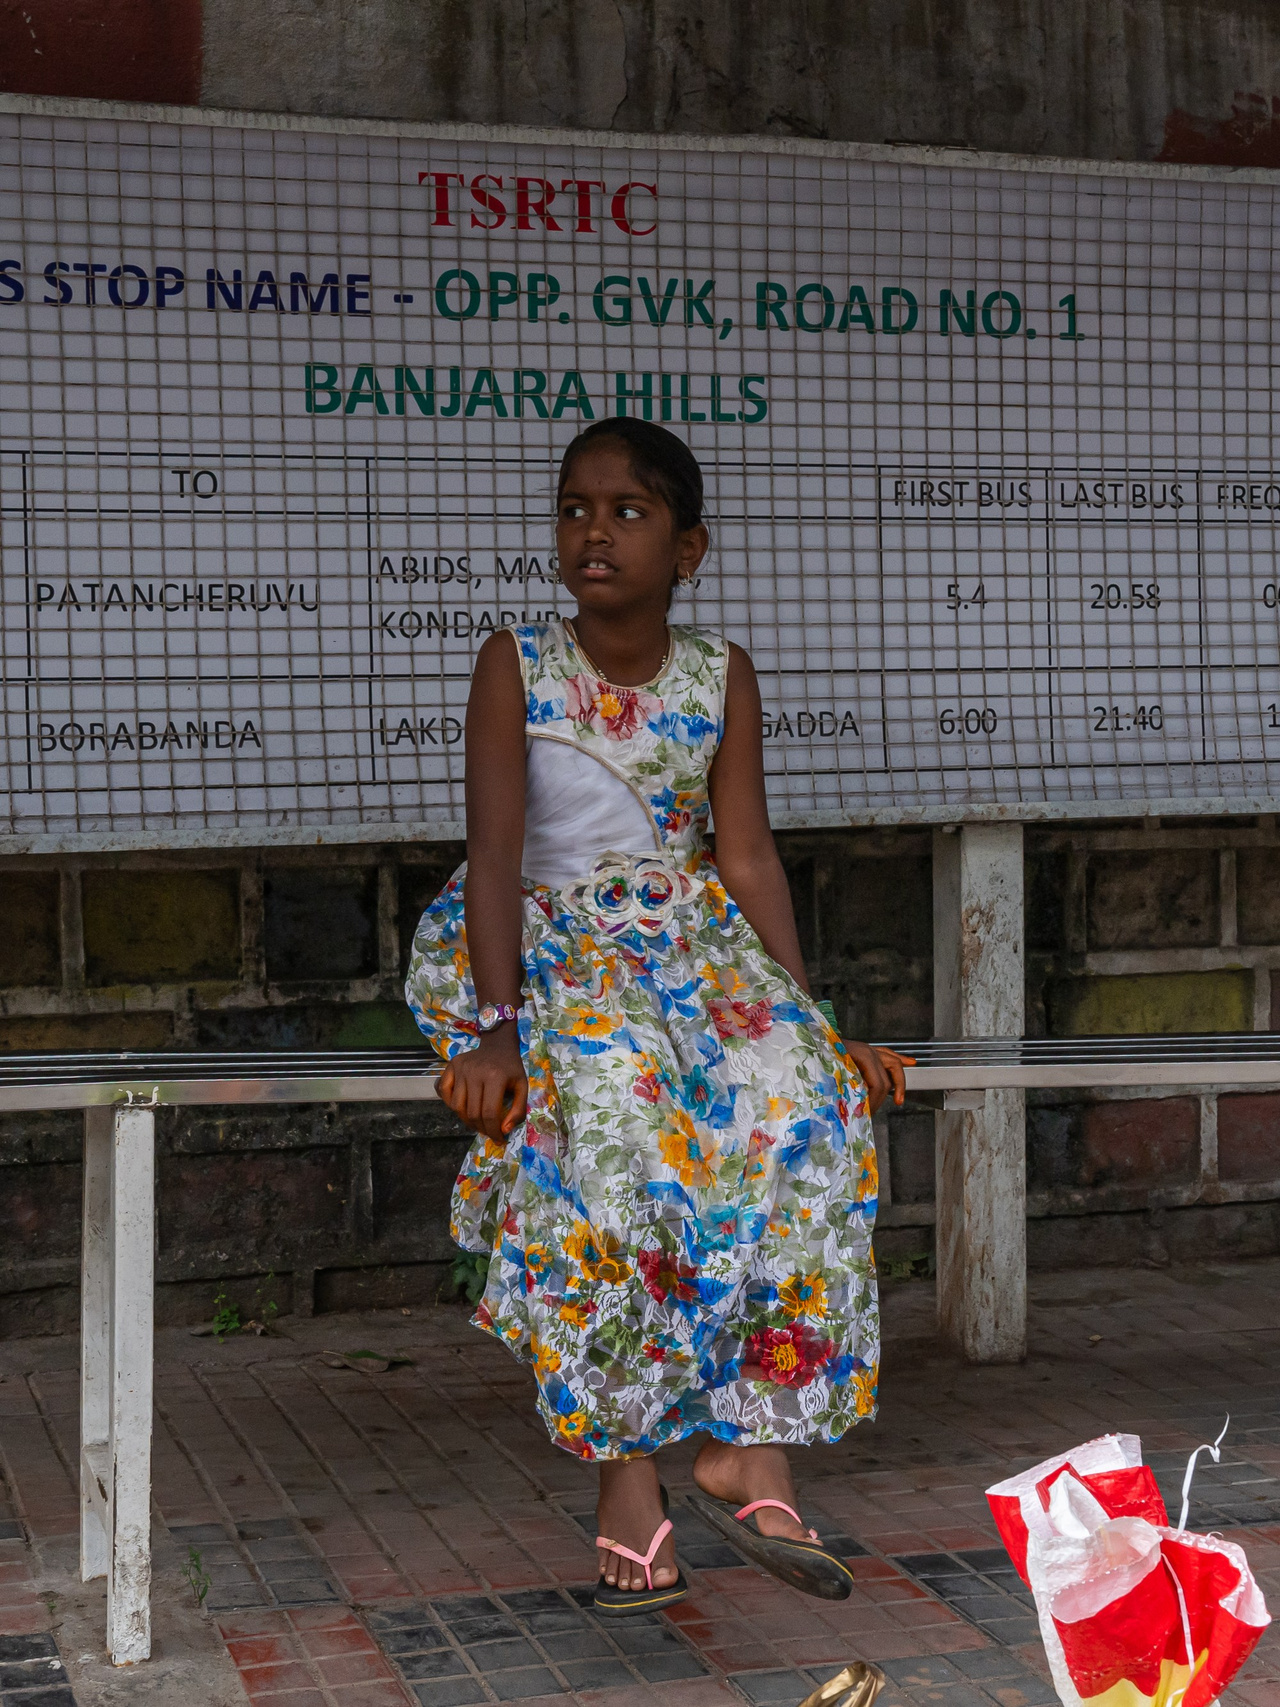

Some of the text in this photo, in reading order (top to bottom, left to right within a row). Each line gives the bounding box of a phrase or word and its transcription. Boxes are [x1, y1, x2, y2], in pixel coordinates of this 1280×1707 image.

[418, 172, 658, 236] TSRTC
[43, 261, 185, 309] STOP
[206, 269, 373, 317] NAME
[435, 269, 570, 324] OPP.
[592, 276, 734, 340] GVK,
[755, 281, 919, 336] ROAD
[939, 289, 1037, 340] NO.
[1058, 294, 1085, 341] 1
[306, 362, 768, 423] BANJARA HILLS
[171, 468, 219, 498] TO
[893, 481, 1033, 508] FIRST BUS
[1059, 483, 1185, 510] LAST BUS
[376, 556, 482, 589] ABIDS,
[35, 582, 319, 613] PATANCHERUVU
[945, 584, 988, 610] 5.4
[1089, 584, 1162, 610] 20.58
[37, 719, 262, 752] BORABANDA
